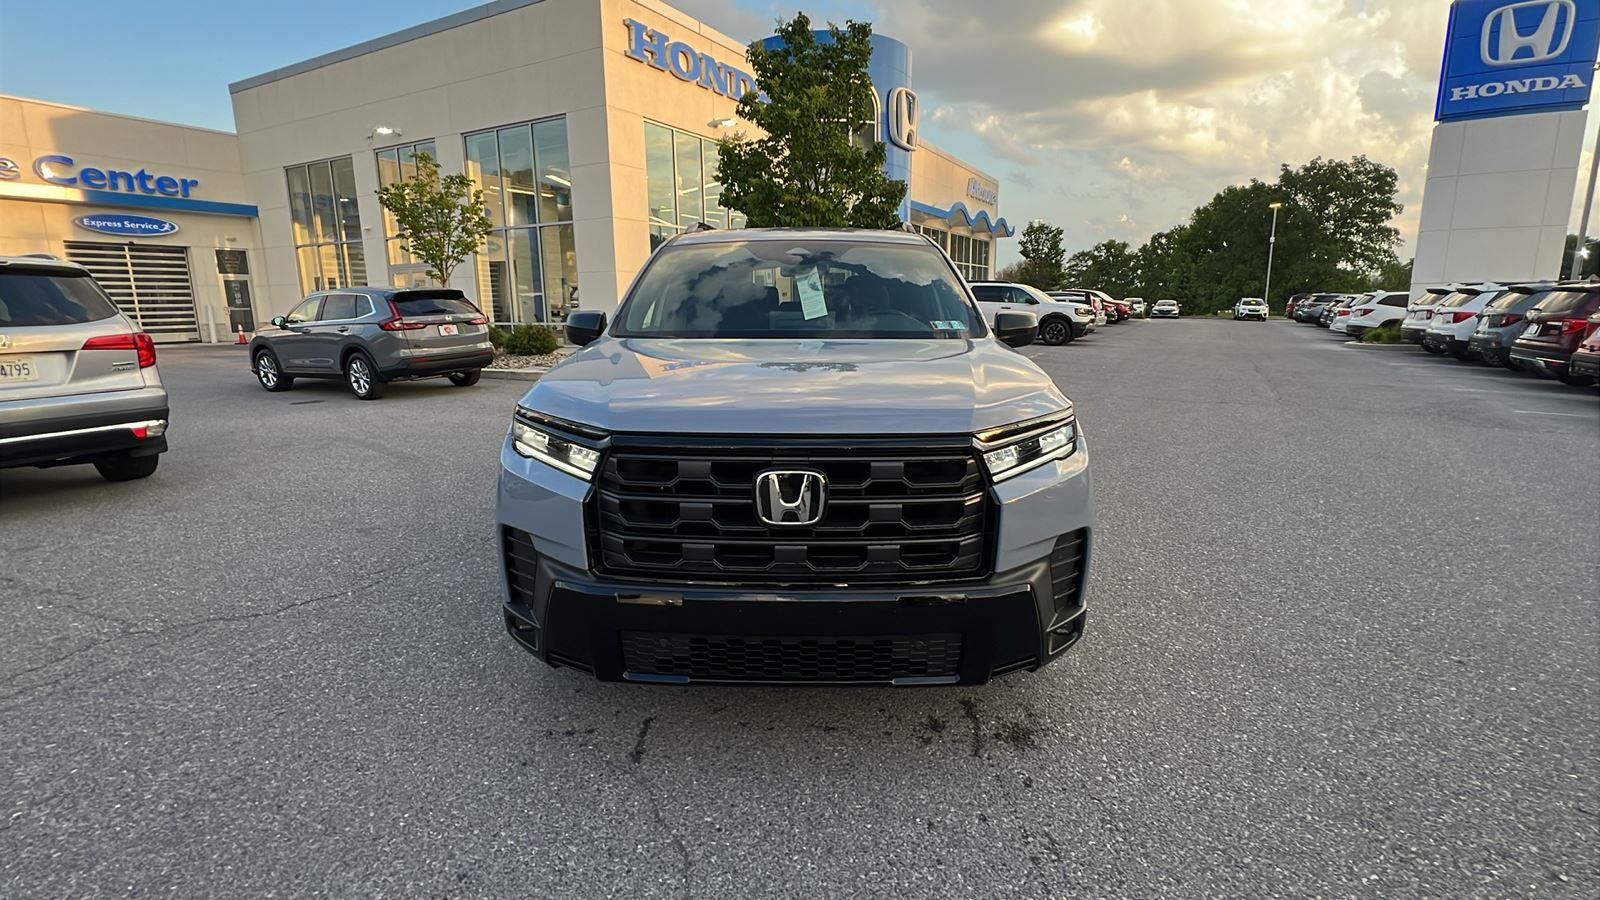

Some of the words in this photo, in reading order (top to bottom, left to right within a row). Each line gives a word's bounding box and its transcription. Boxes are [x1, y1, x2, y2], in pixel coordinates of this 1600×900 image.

[623, 18, 770, 104] HOND
[1450, 74, 1587, 101] HONDA
[33, 154, 199, 198] Center
[83, 217, 122, 229] Express
[123, 220, 159, 230] Service
